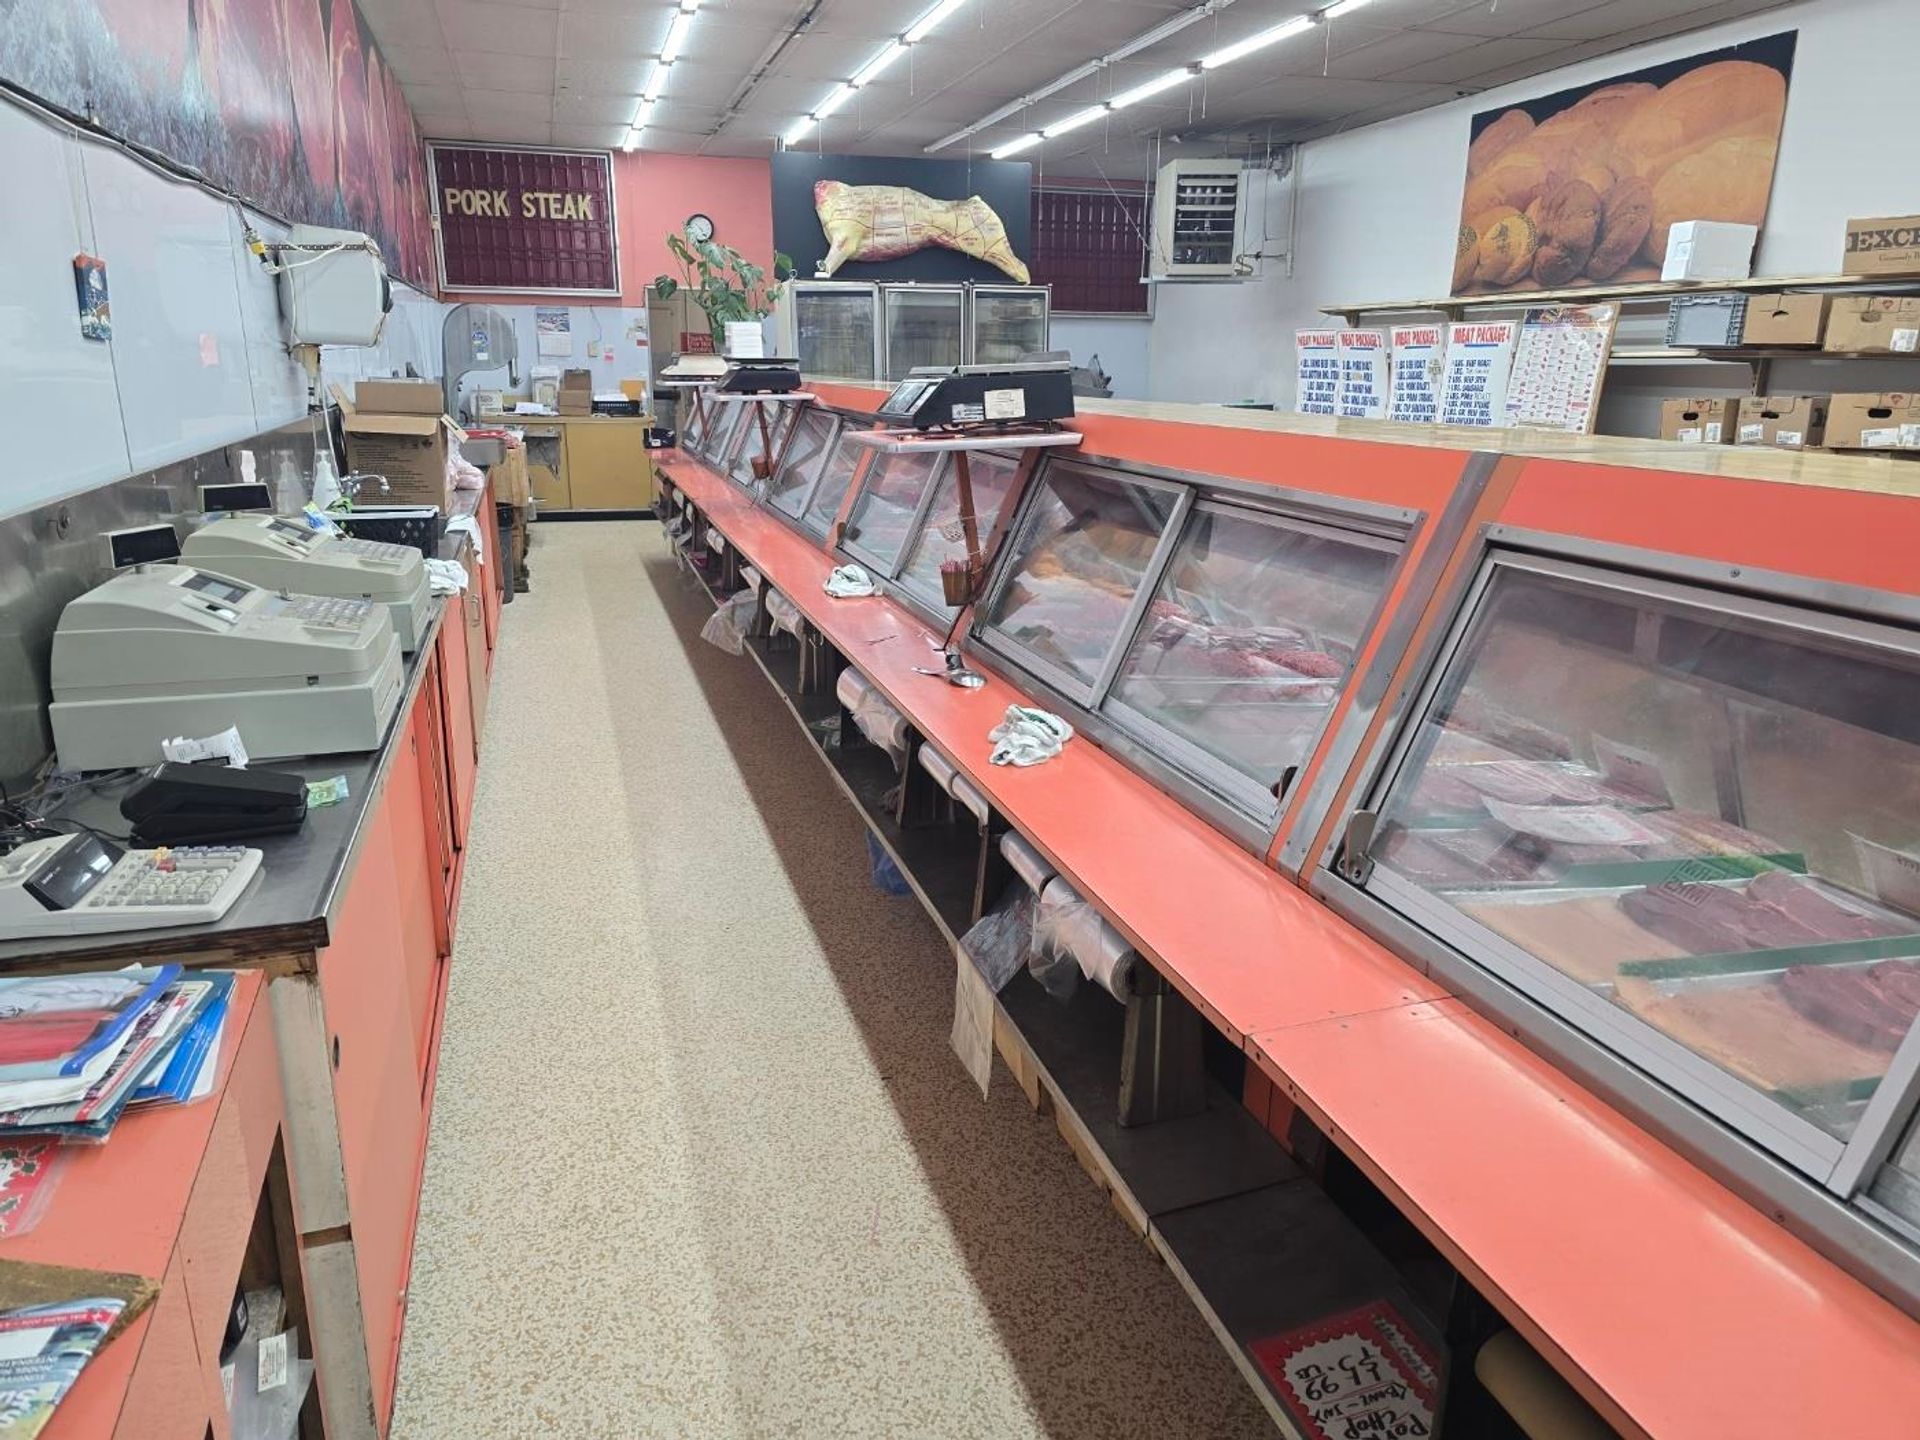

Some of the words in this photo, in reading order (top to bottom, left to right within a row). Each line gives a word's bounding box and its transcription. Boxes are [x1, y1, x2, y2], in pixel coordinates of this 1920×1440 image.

[444, 187, 511, 217] PORK
[521, 191, 594, 220] STEAK
[1297, 335, 1310, 346] MEAT
[1312, 335, 1335, 346] PACKAGE
[1341, 333, 1355, 346] MEAT
[1356, 333, 1378, 347] PACKAGE
[1395, 331, 1411, 346] MEAT
[1412, 330, 1434, 345] PACKAGE
[1454, 327, 1476, 344] MEAT
[1476, 326, 1506, 343] PACKAGE
